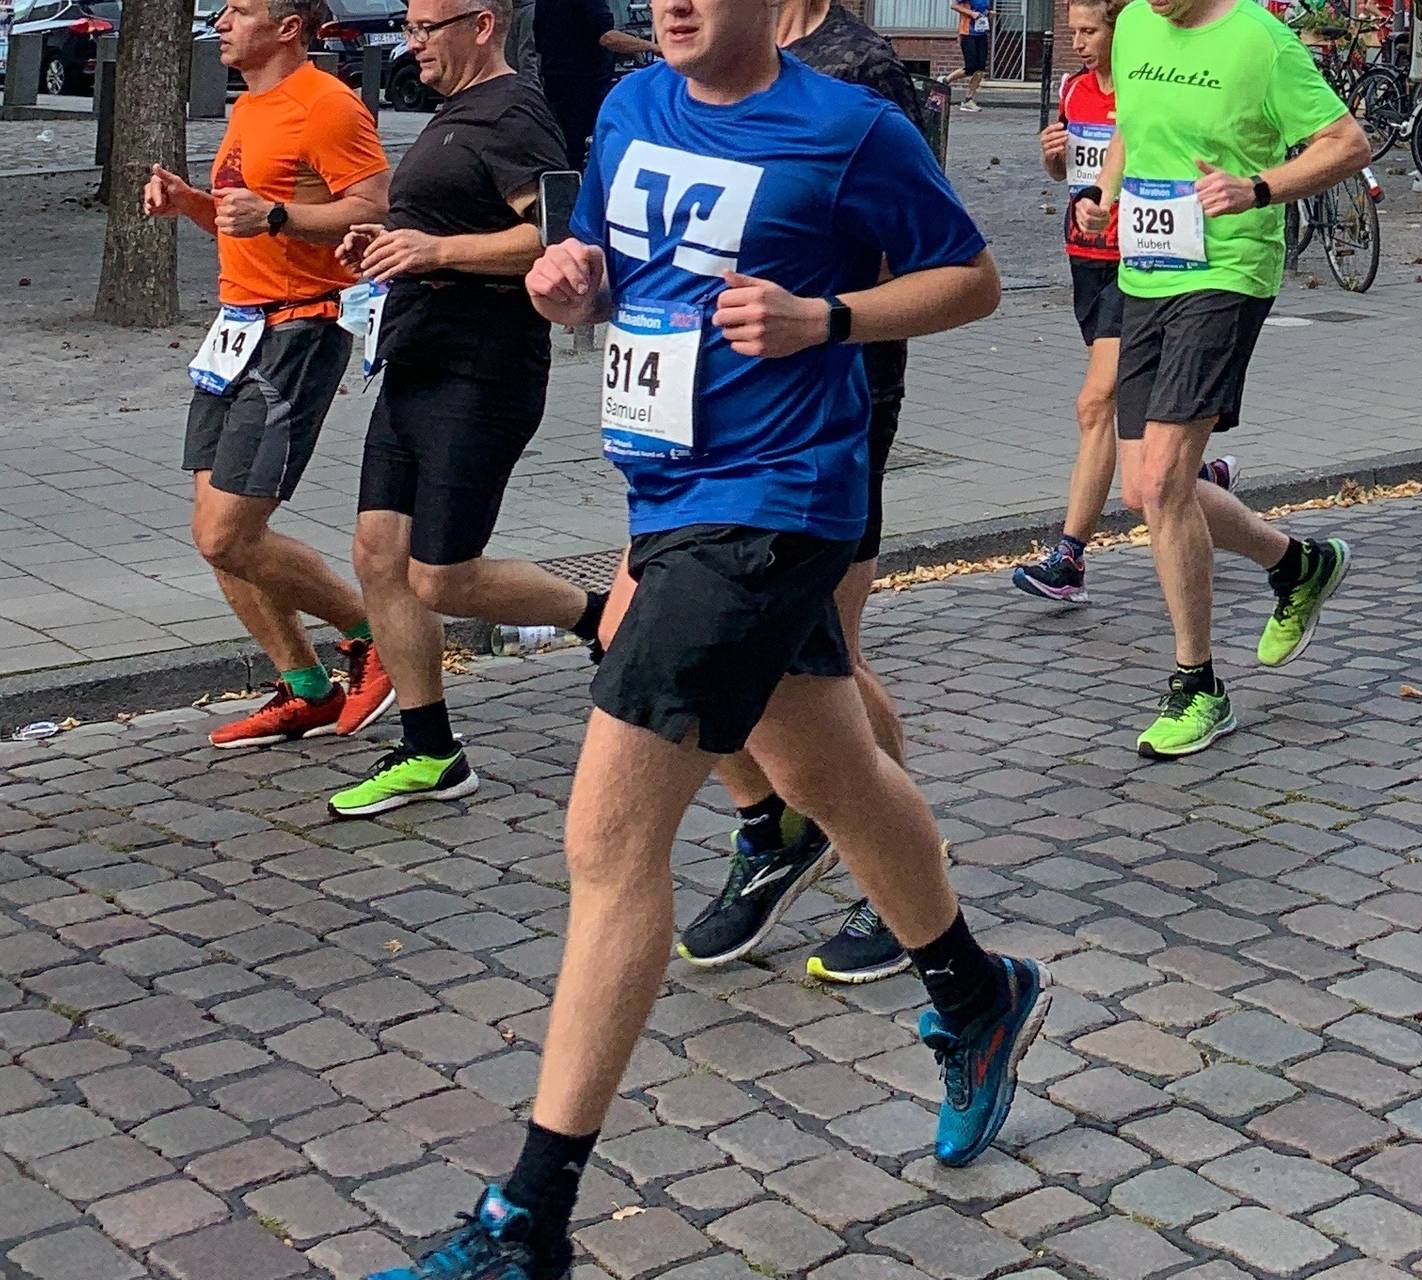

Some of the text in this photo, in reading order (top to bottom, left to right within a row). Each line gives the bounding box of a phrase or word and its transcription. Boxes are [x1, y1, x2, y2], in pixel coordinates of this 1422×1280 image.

[1127, 61, 1223, 90] Athletic
[1132, 206, 1175, 236] 329
[1136, 238, 1172, 250] Hubert
[212, 328, 247, 358] 14
[605, 343, 661, 398] 314
[605, 396, 653, 423] Samuel
